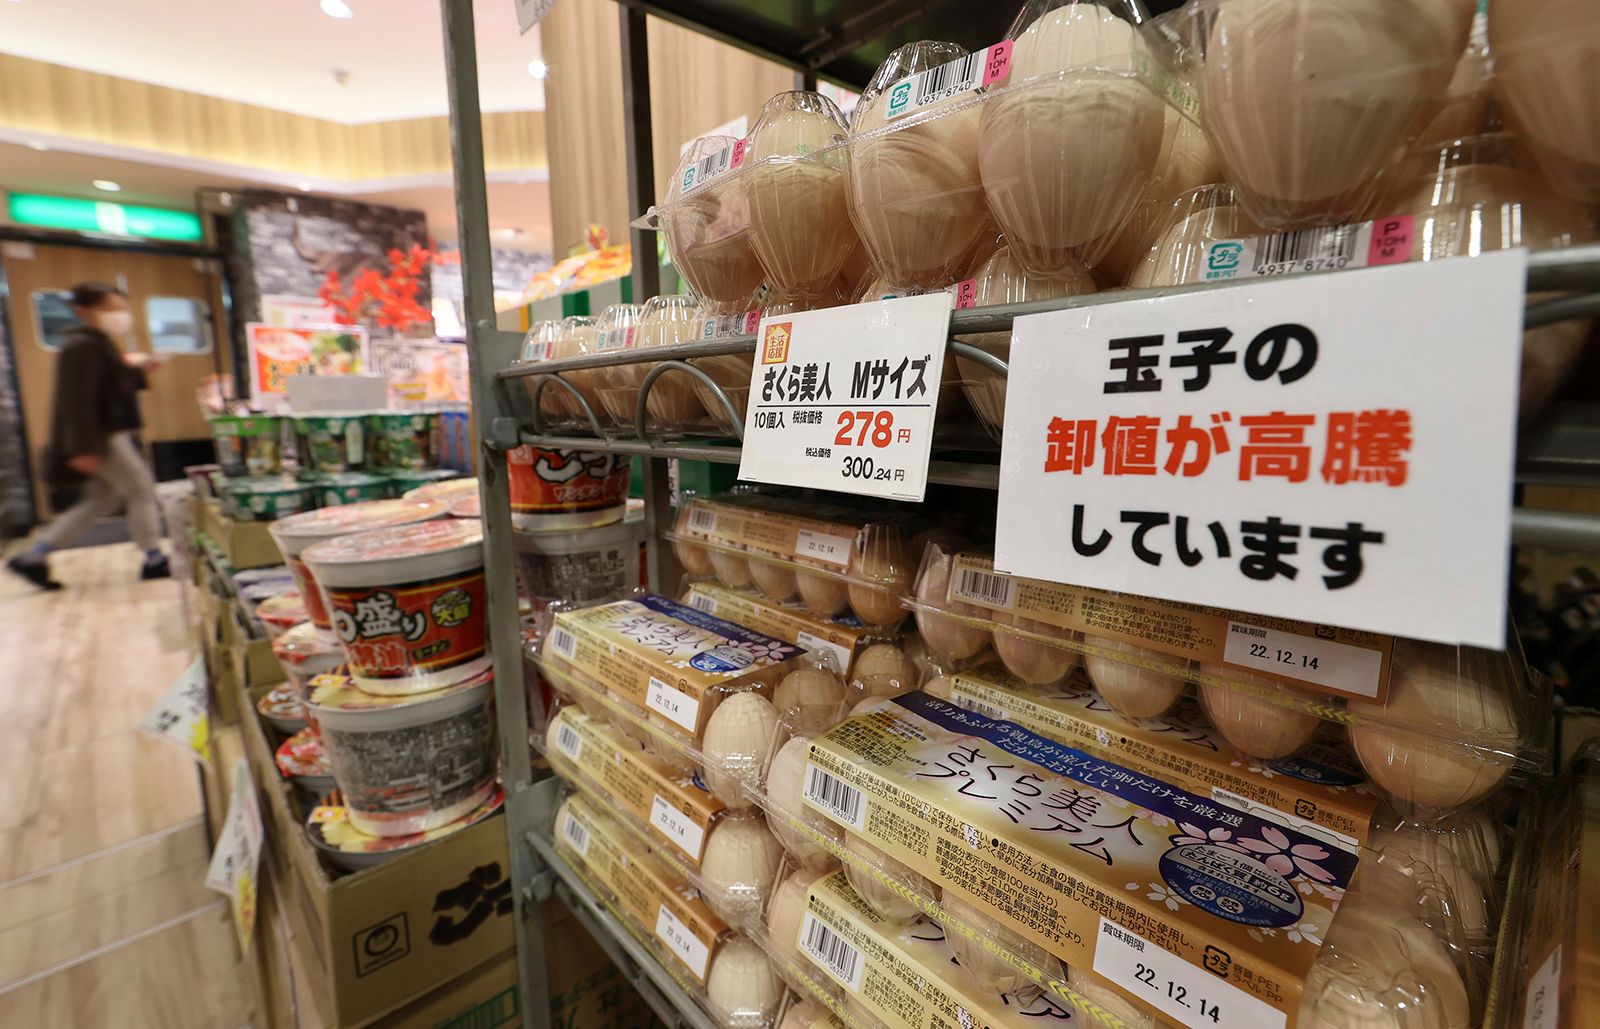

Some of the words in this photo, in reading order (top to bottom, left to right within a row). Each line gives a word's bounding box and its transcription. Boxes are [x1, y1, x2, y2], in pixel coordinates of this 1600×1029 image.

[993, 47, 1004, 60] P
[1383, 221, 1400, 235] P
[1257, 262, 1296, 276] 4937
[1304, 257, 1348, 272] 8740
[962, 284, 970, 294] P
[768, 335, 785, 348] 生活
[1104, 323, 1320, 394] 玉子の
[762, 362, 832, 401] さくら美人
[850, 354, 931, 400] Mサイズ
[754, 412, 785, 429] 10個入
[792, 410, 823, 425] 税抜価格
[1044, 408, 1415, 487] 卸値が高騰
[1070, 504, 1386, 591] しています
[1230, 623, 1267, 639] 賞味期限
[997, 736, 1120, 791] だからおいしい
[947, 745, 1144, 846] さくら美人
[916, 762, 1113, 866] プレミアム
[1102, 922, 1145, 953] 賞味期限
